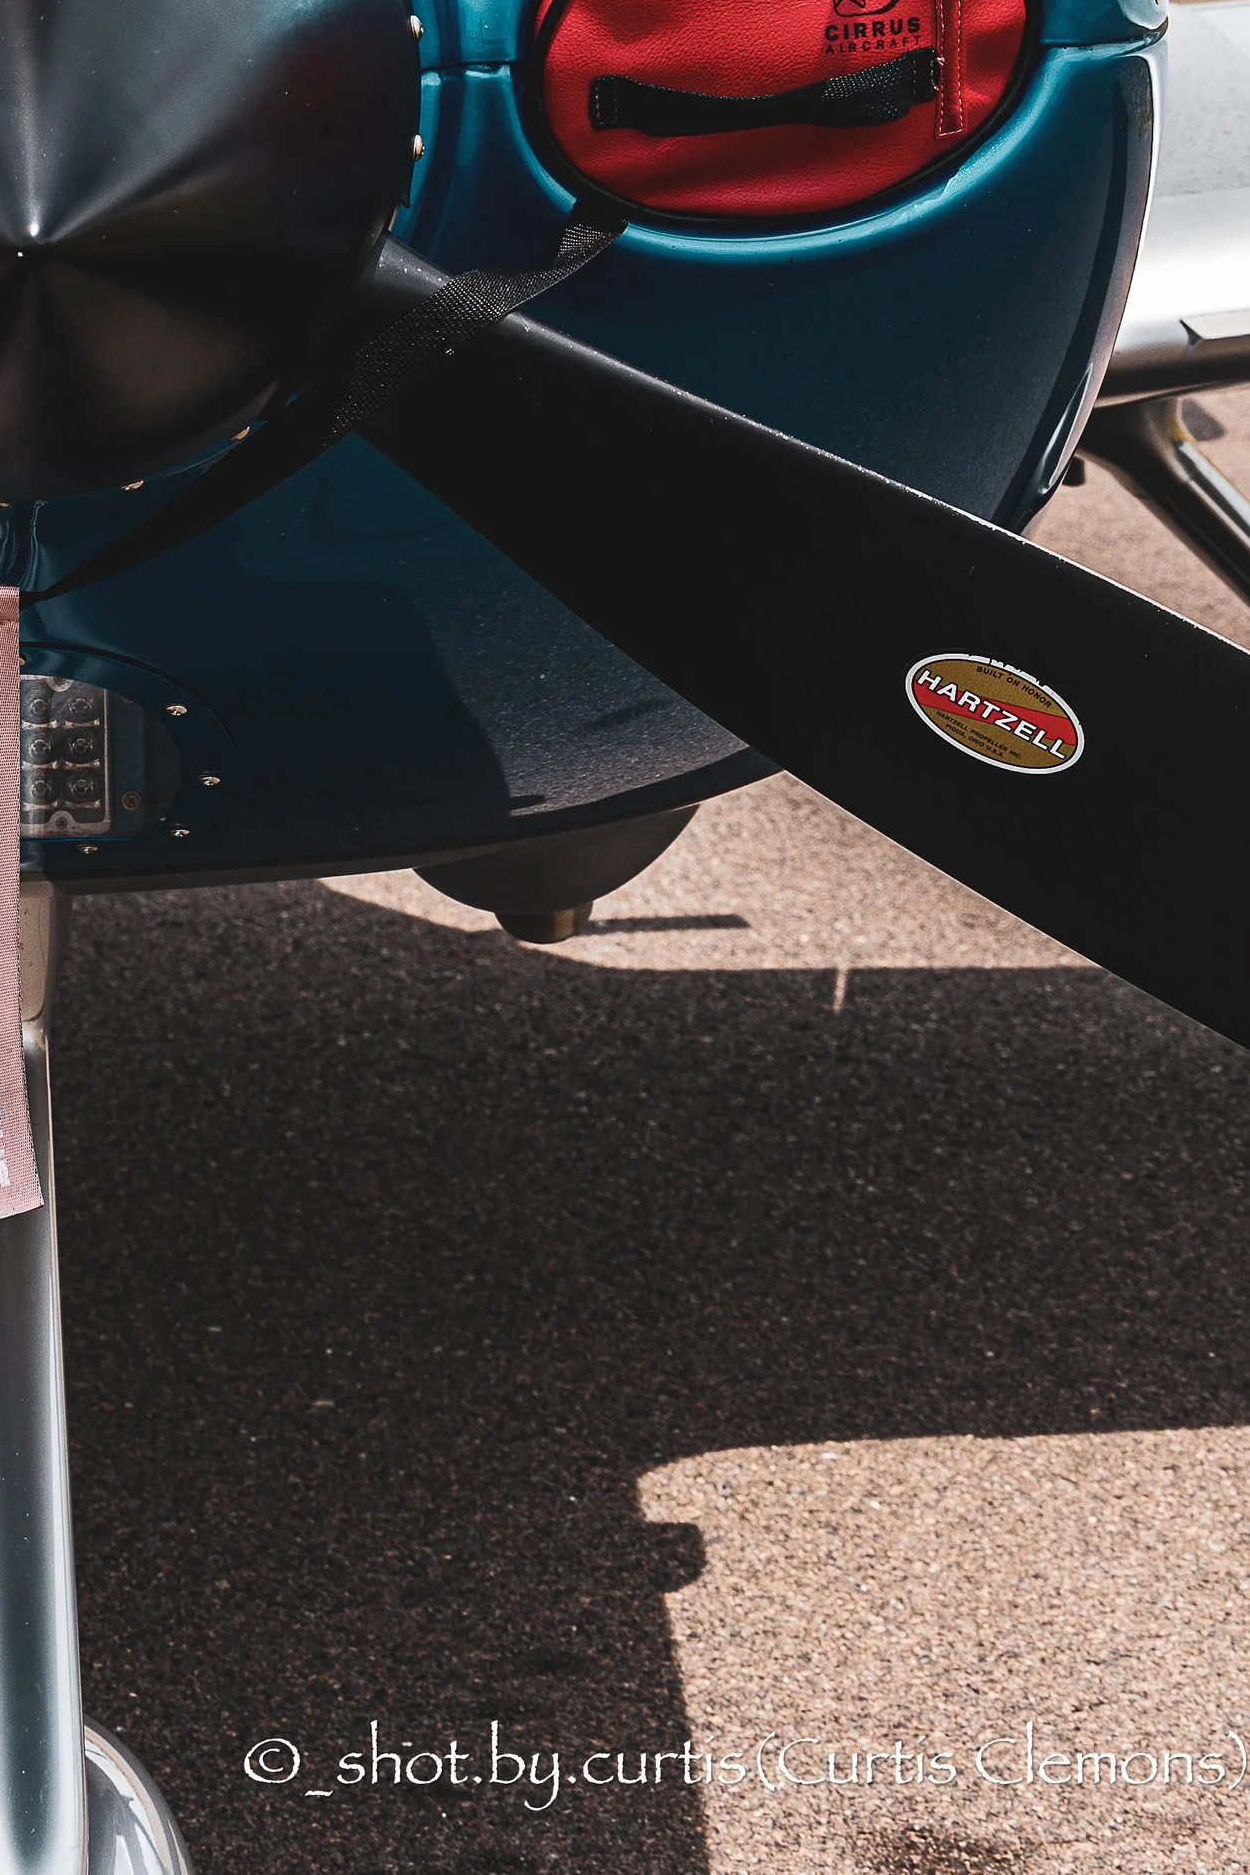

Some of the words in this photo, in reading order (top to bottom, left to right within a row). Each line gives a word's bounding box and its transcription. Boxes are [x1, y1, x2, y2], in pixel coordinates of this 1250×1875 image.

[824, 17, 920, 41] CIRRUS
[825, 36, 921, 54] AIRCRAFT
[976, 666, 1005, 679] BUILT
[1006, 676, 1021, 687] ON
[1021, 684, 1052, 708] HONOR
[917, 670, 1066, 760] HARTZELL
[936, 710, 968, 731] HARTZELL
[970, 729, 1008, 752] PROPELLER
[1009, 749, 1022, 760] INC.
[968, 735, 985, 747] OHIO
